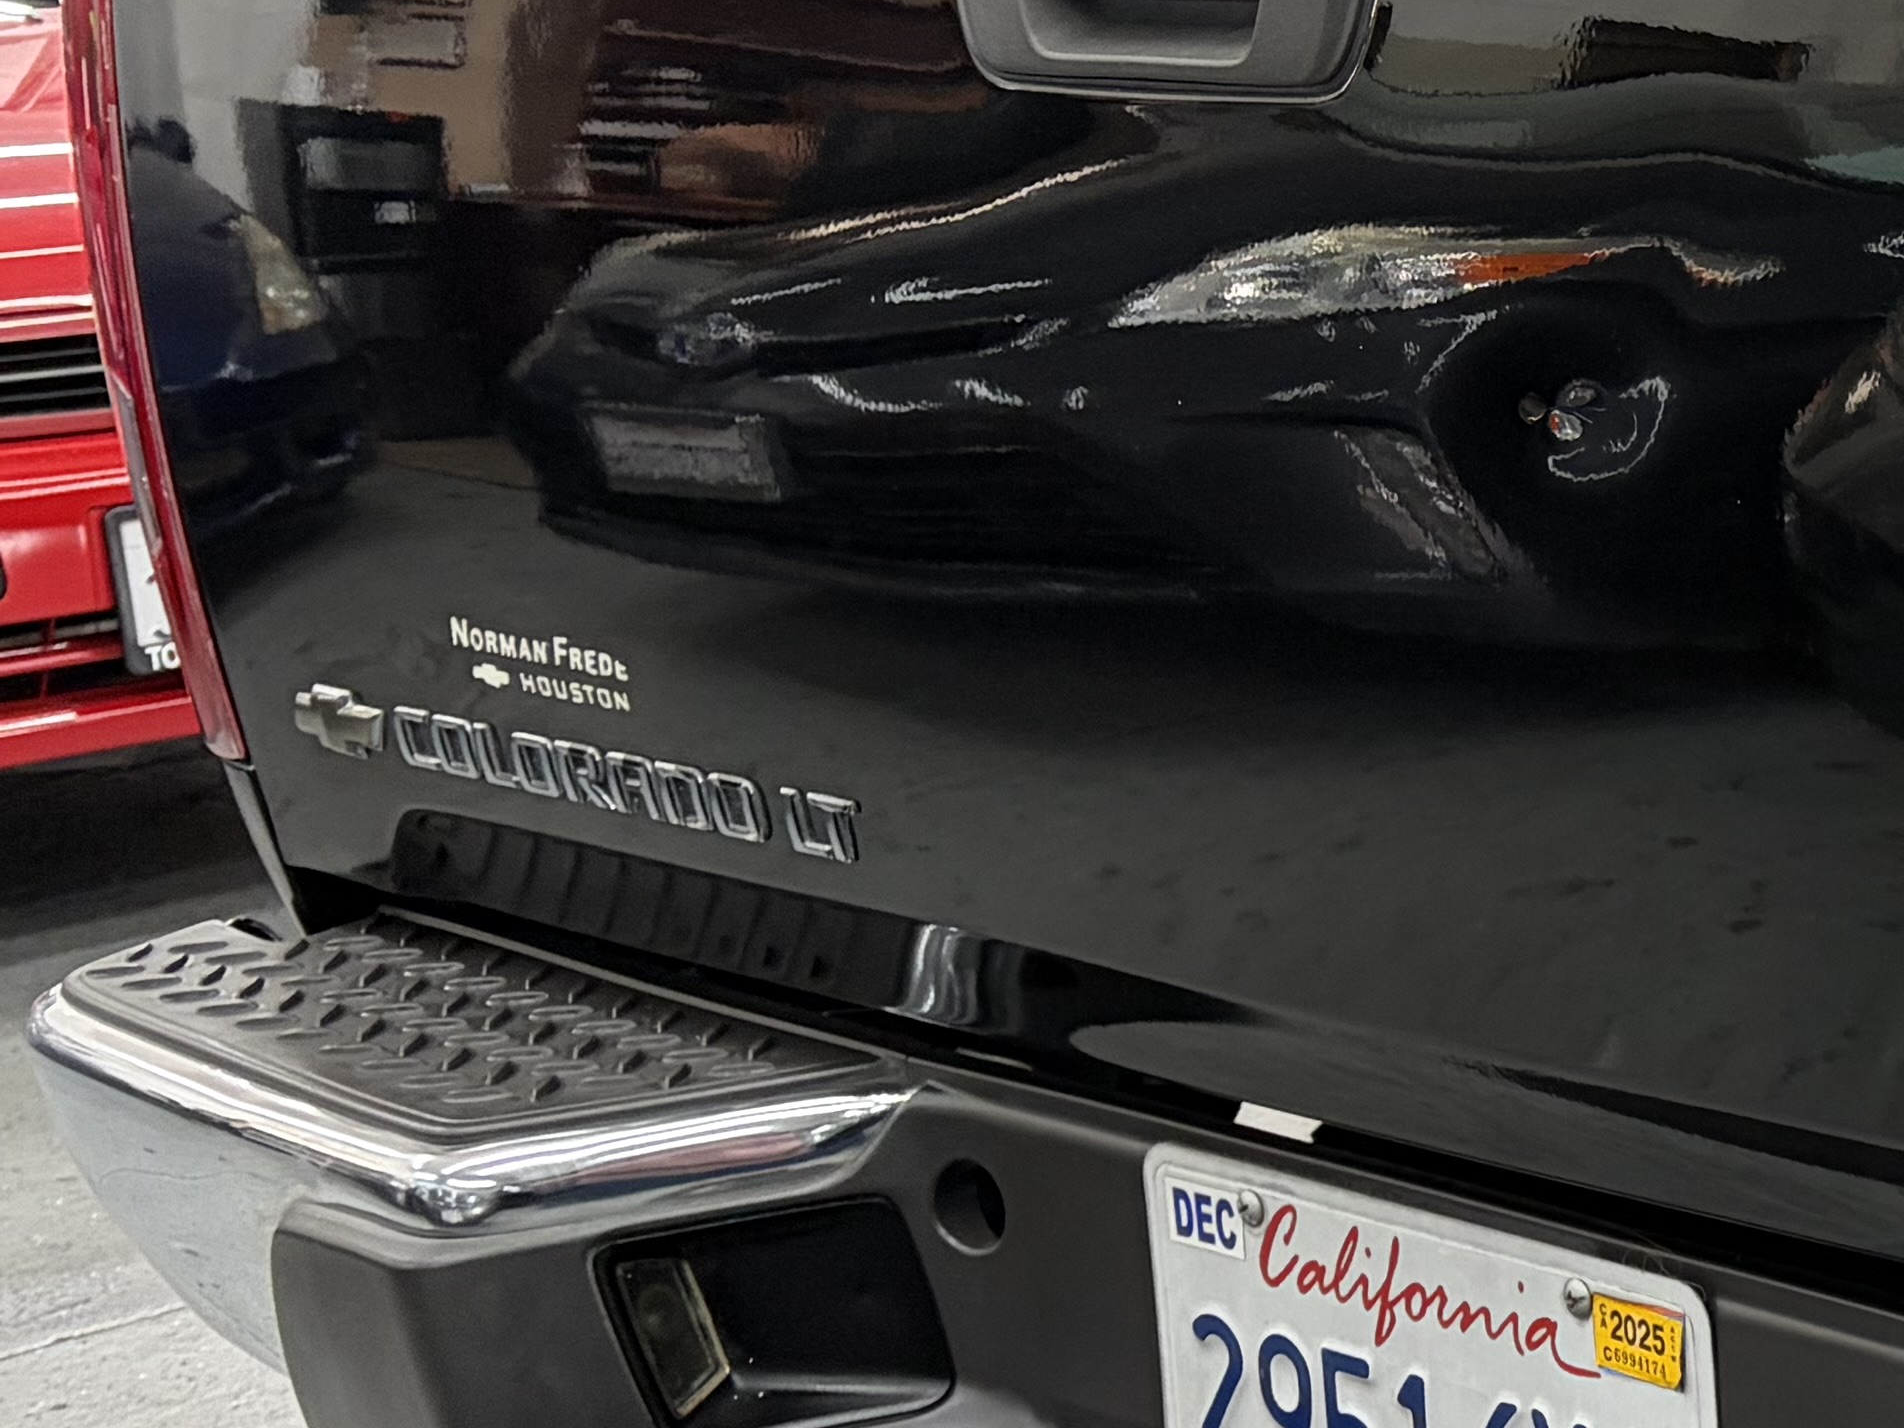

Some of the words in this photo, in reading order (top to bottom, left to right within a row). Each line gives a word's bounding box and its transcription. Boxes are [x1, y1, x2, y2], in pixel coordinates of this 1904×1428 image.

[519, 671, 631, 713] HOUSTON
[392, 704, 774, 845] COLORADO
[779, 786, 862, 864] LT
[1171, 1186, 1238, 1251] DEC
[1258, 1202, 1602, 1378] California
[1609, 1309, 1667, 1357] 2025
